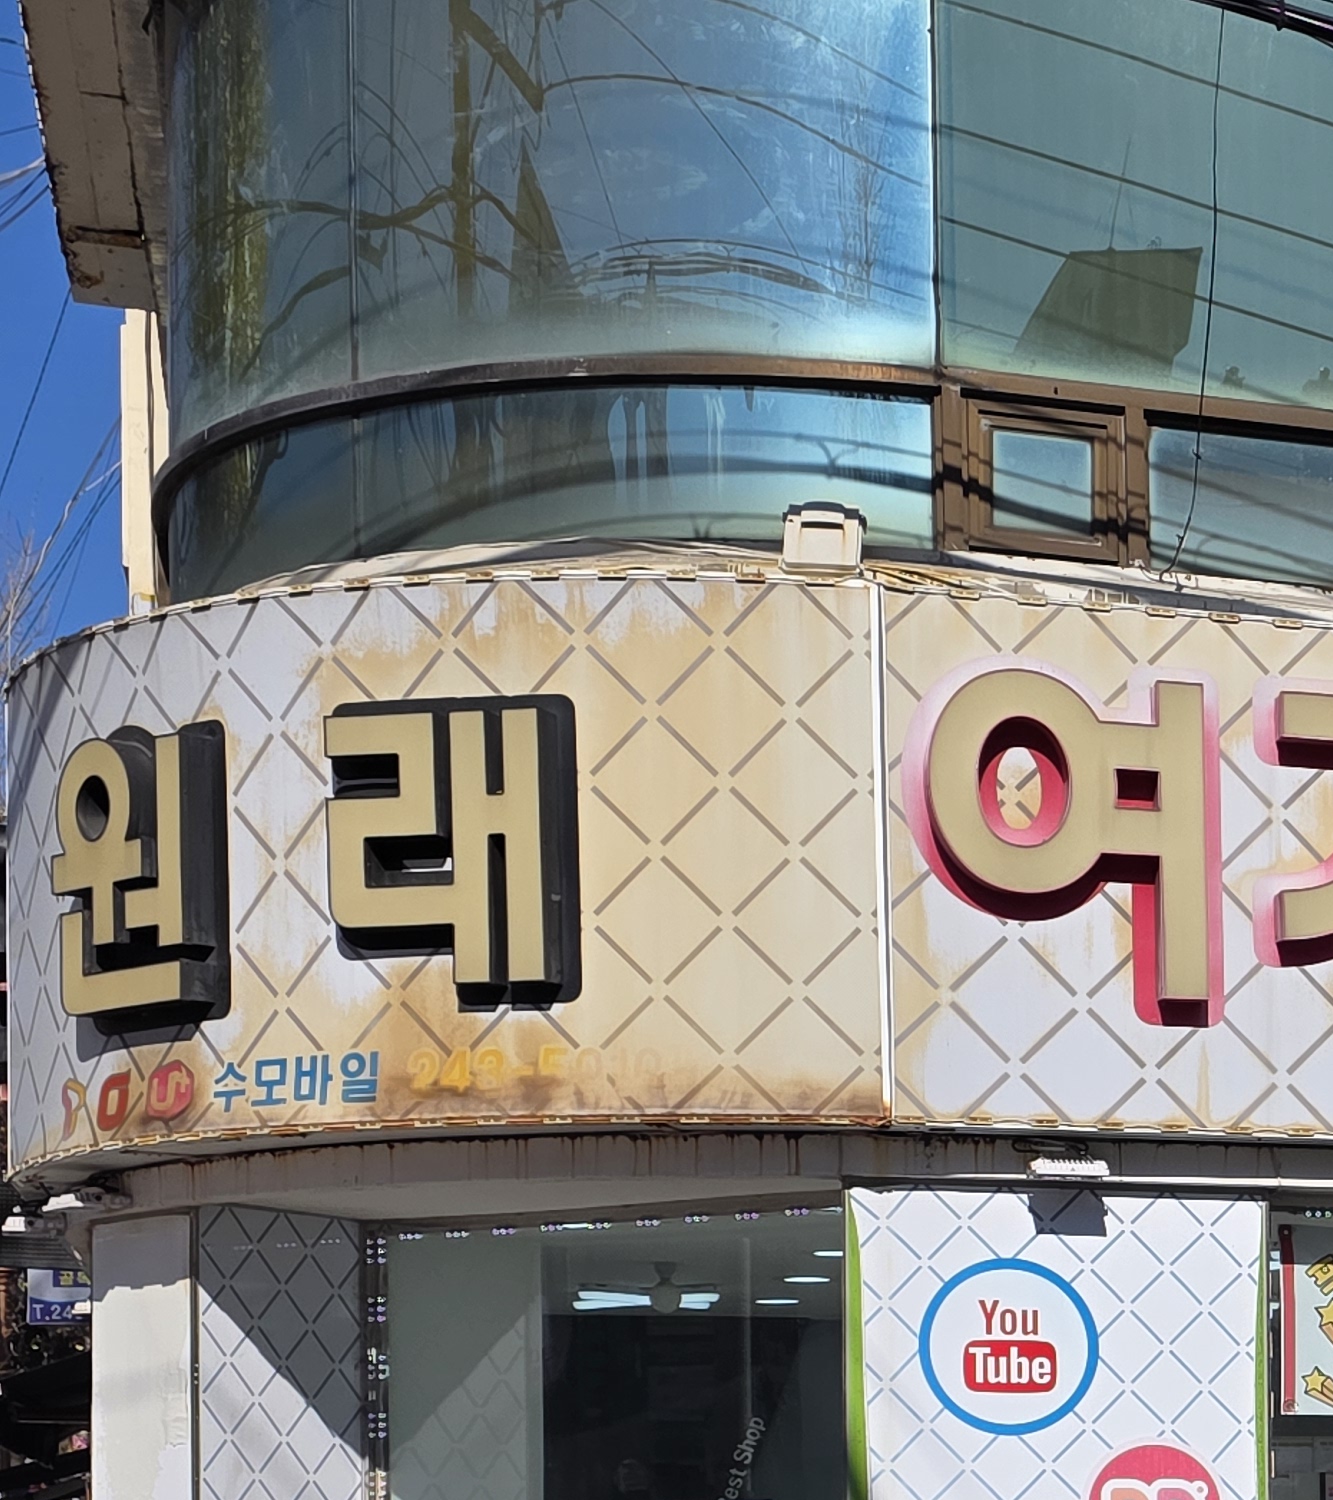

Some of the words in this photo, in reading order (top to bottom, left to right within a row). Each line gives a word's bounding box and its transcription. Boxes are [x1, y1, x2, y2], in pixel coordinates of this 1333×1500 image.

[212, 1050, 380, 1112] 수모바일
[978, 1300, 1039, 1335] You
[968, 1347, 1051, 1384] Tube
